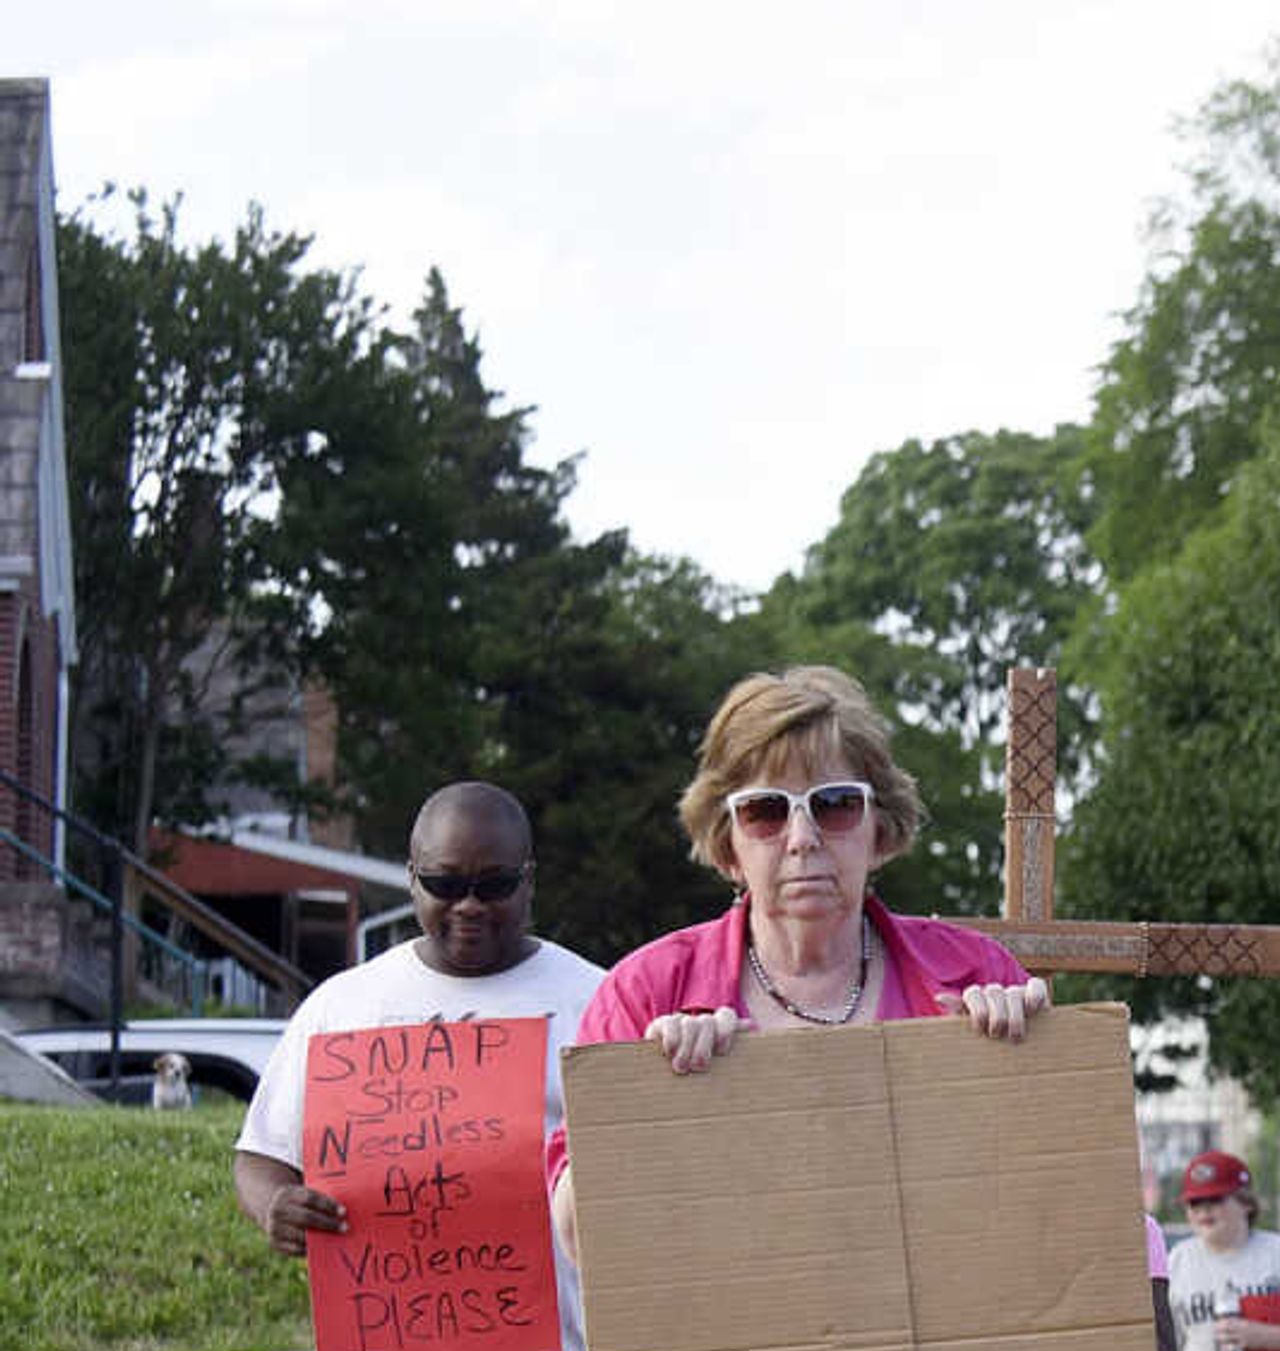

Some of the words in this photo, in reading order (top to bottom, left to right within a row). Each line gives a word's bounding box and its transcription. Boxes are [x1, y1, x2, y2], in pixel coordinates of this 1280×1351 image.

[314, 1023, 509, 1082] SNAP
[348, 1080, 459, 1118] Stop
[318, 1113, 507, 1169] Needless
